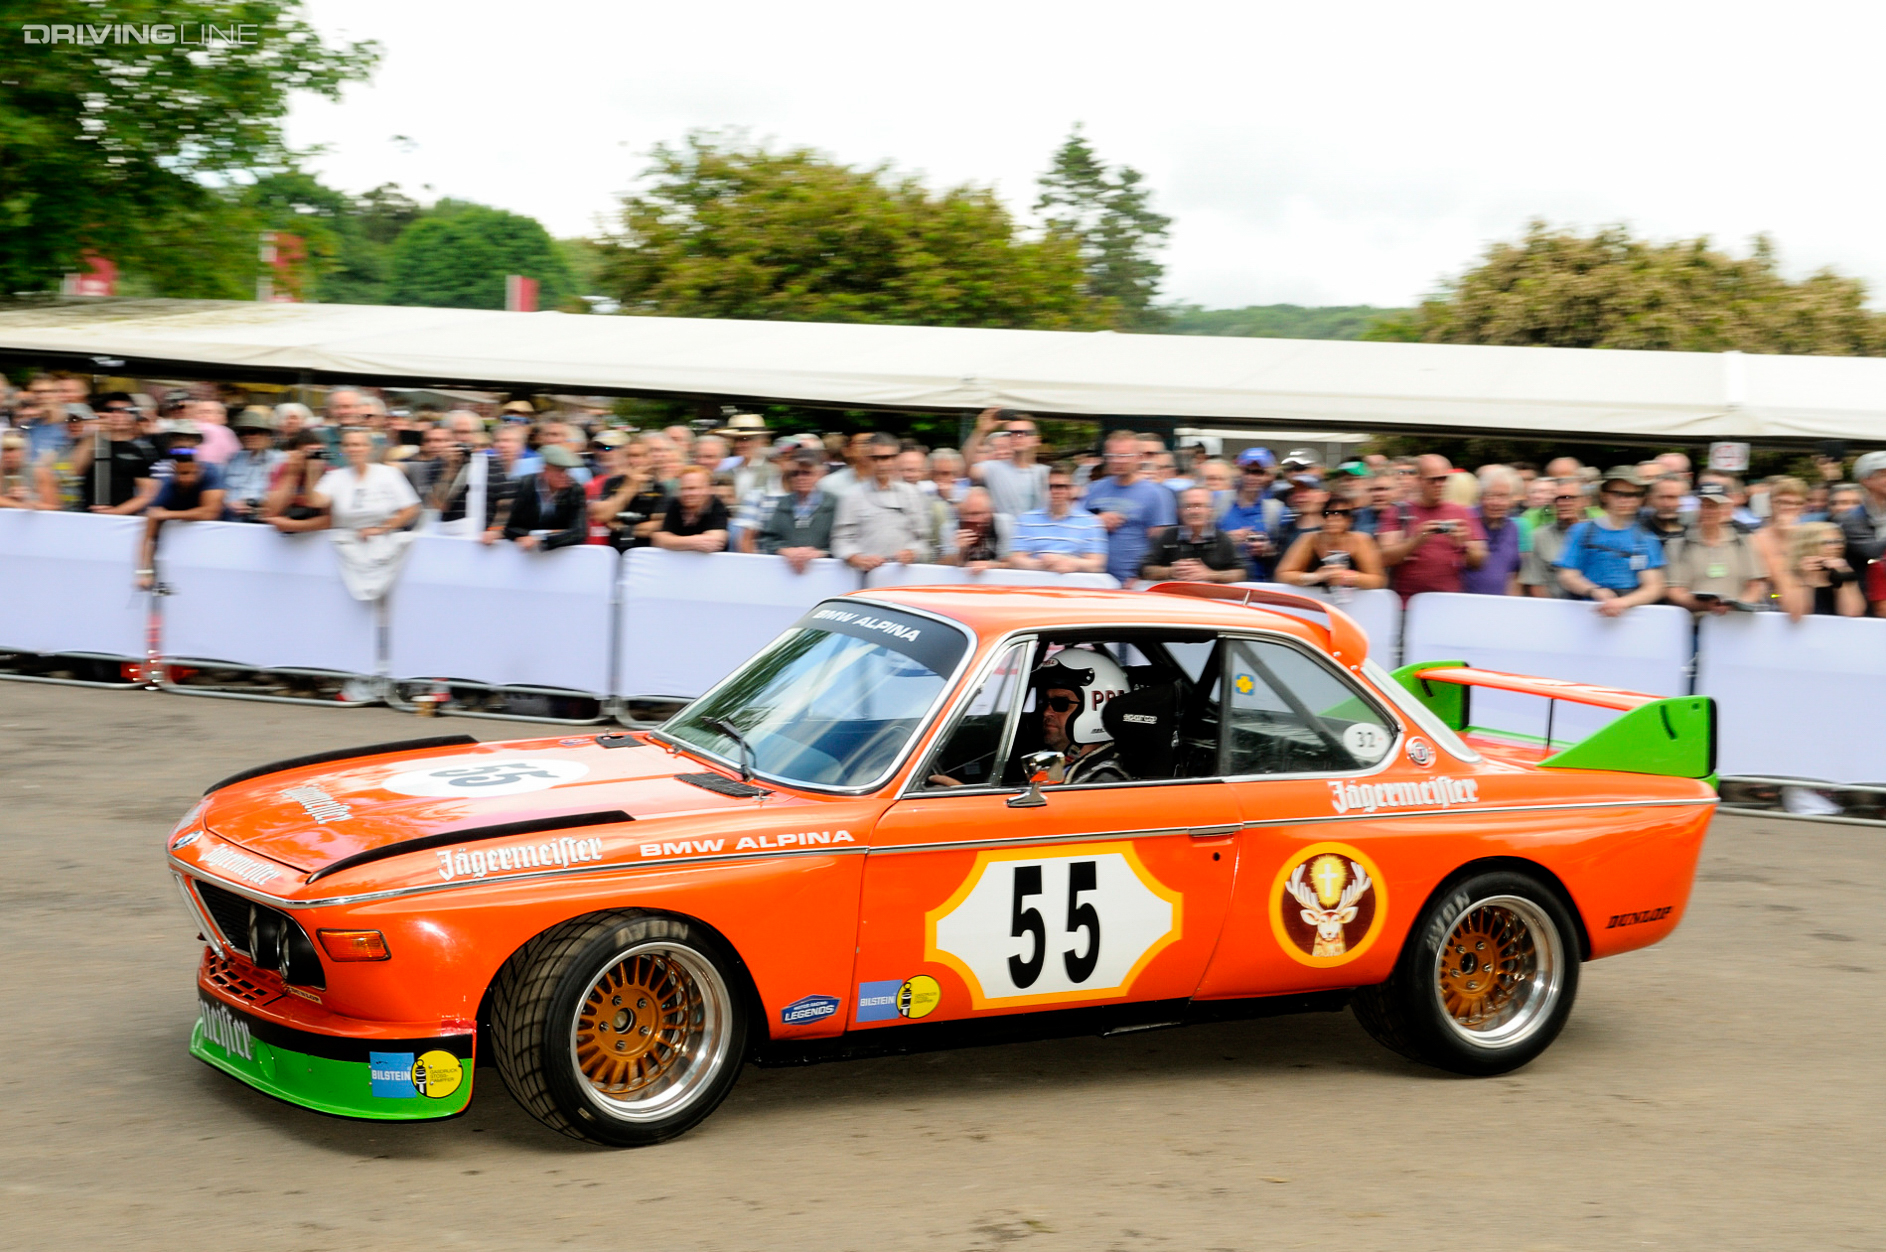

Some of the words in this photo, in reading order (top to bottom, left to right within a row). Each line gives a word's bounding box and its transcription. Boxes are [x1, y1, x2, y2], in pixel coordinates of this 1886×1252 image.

[812, 609, 859, 622] BMW
[852, 616, 921, 642] ALPINA
[1356, 731, 1376, 748] 32
[428, 763, 561, 787] 55
[1327, 776, 1479, 814] Jägermeister
[639, 839, 725, 857] BMW
[735, 830, 855, 850] ALPINA
[436, 836, 603, 881] Jägermeister
[1007, 861, 1101, 989] 55
[1604, 905, 1675, 929] DUNLOP
[784, 1004, 835, 1021] LEGENDS
[860, 995, 896, 1007] BILSTEIN
[371, 1069, 411, 1081] BILSTEIN
